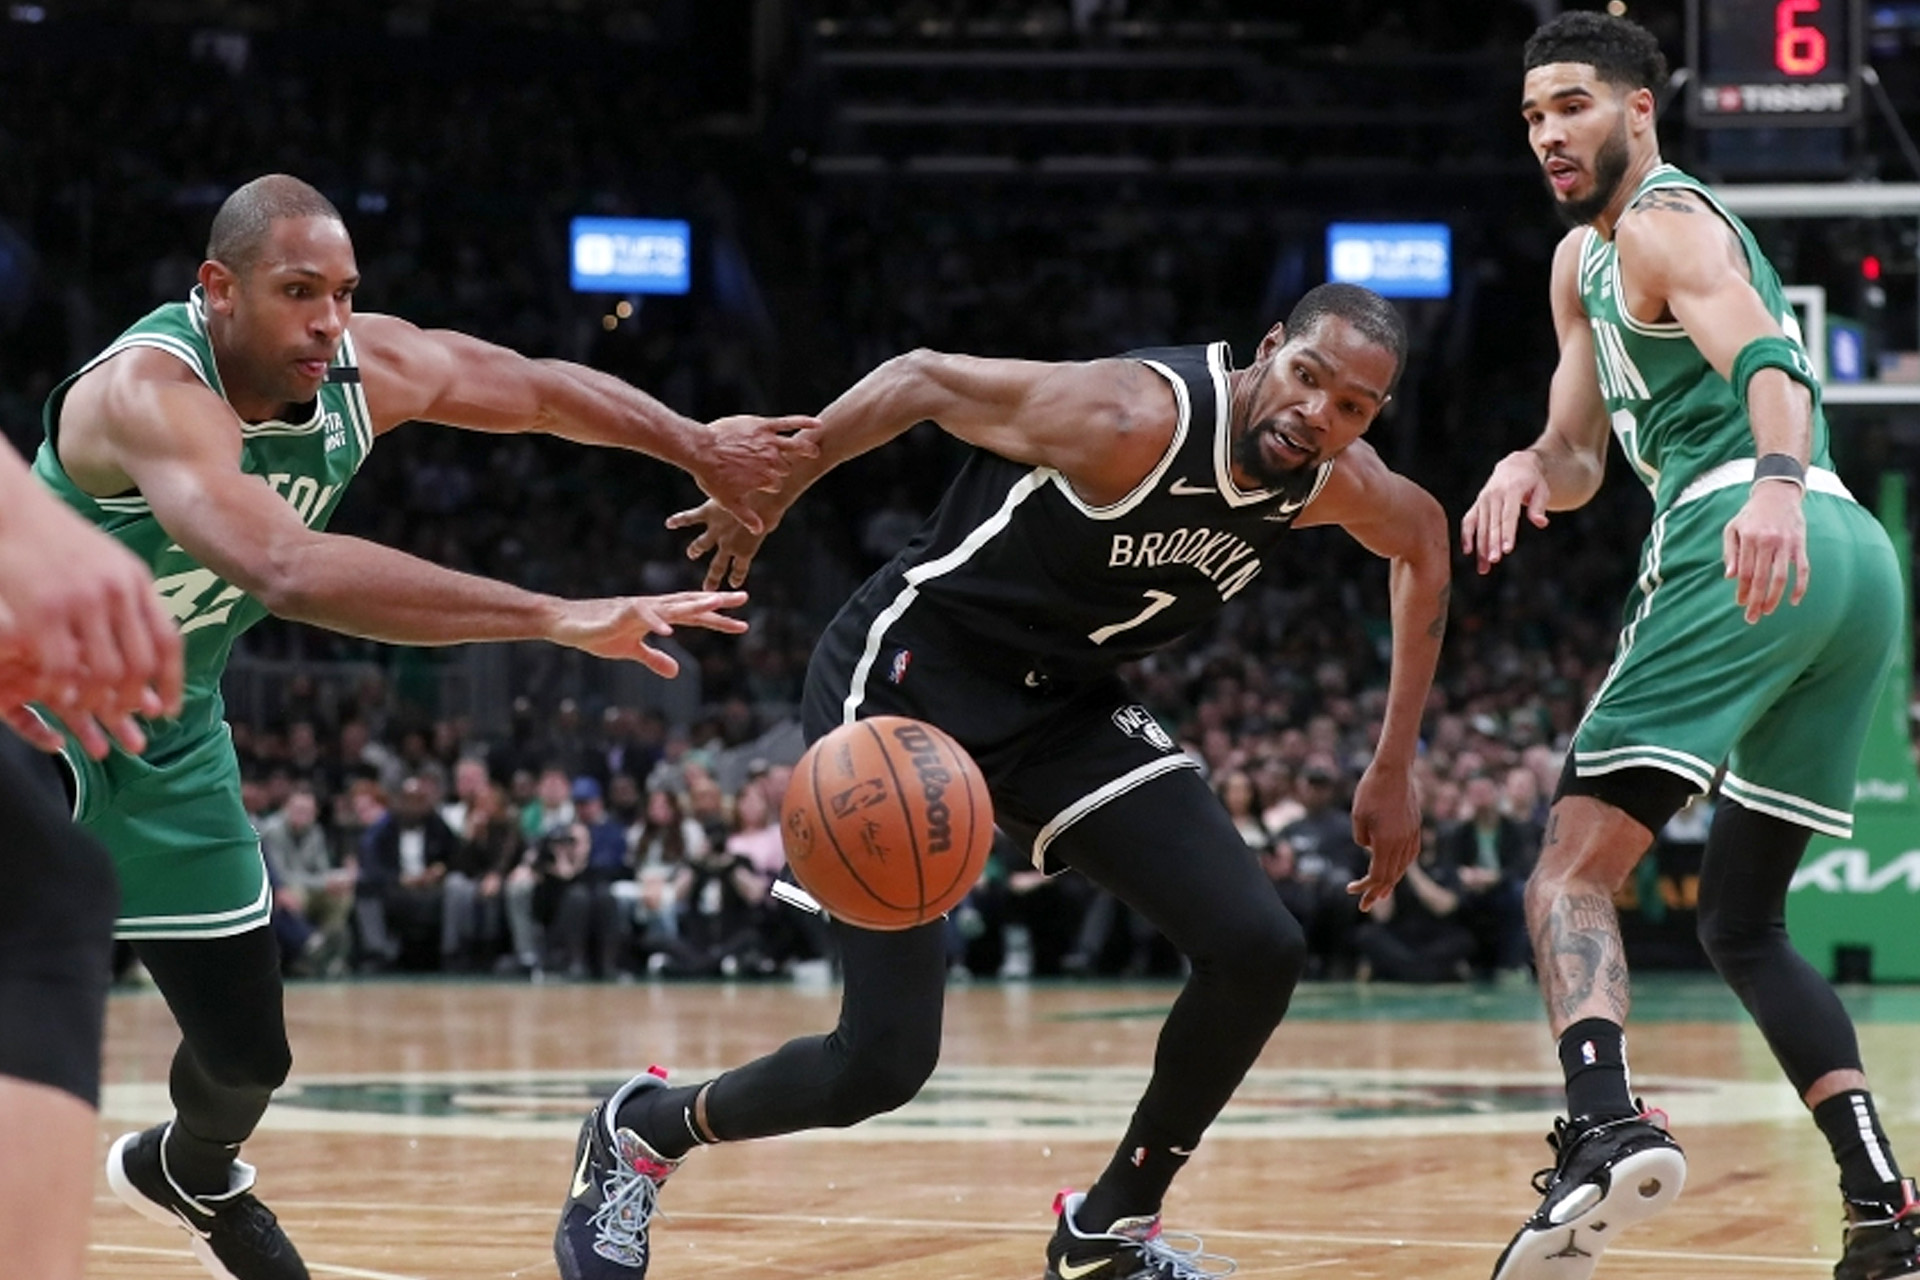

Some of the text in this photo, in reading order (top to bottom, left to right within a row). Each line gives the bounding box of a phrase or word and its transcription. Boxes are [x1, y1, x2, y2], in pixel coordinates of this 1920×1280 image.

[1775, 0, 1826, 76] 6
[1108, 527, 1262, 602] BROOKLYN
[1087, 589, 1178, 646] 7
[893, 723, 953, 856] Wilson
